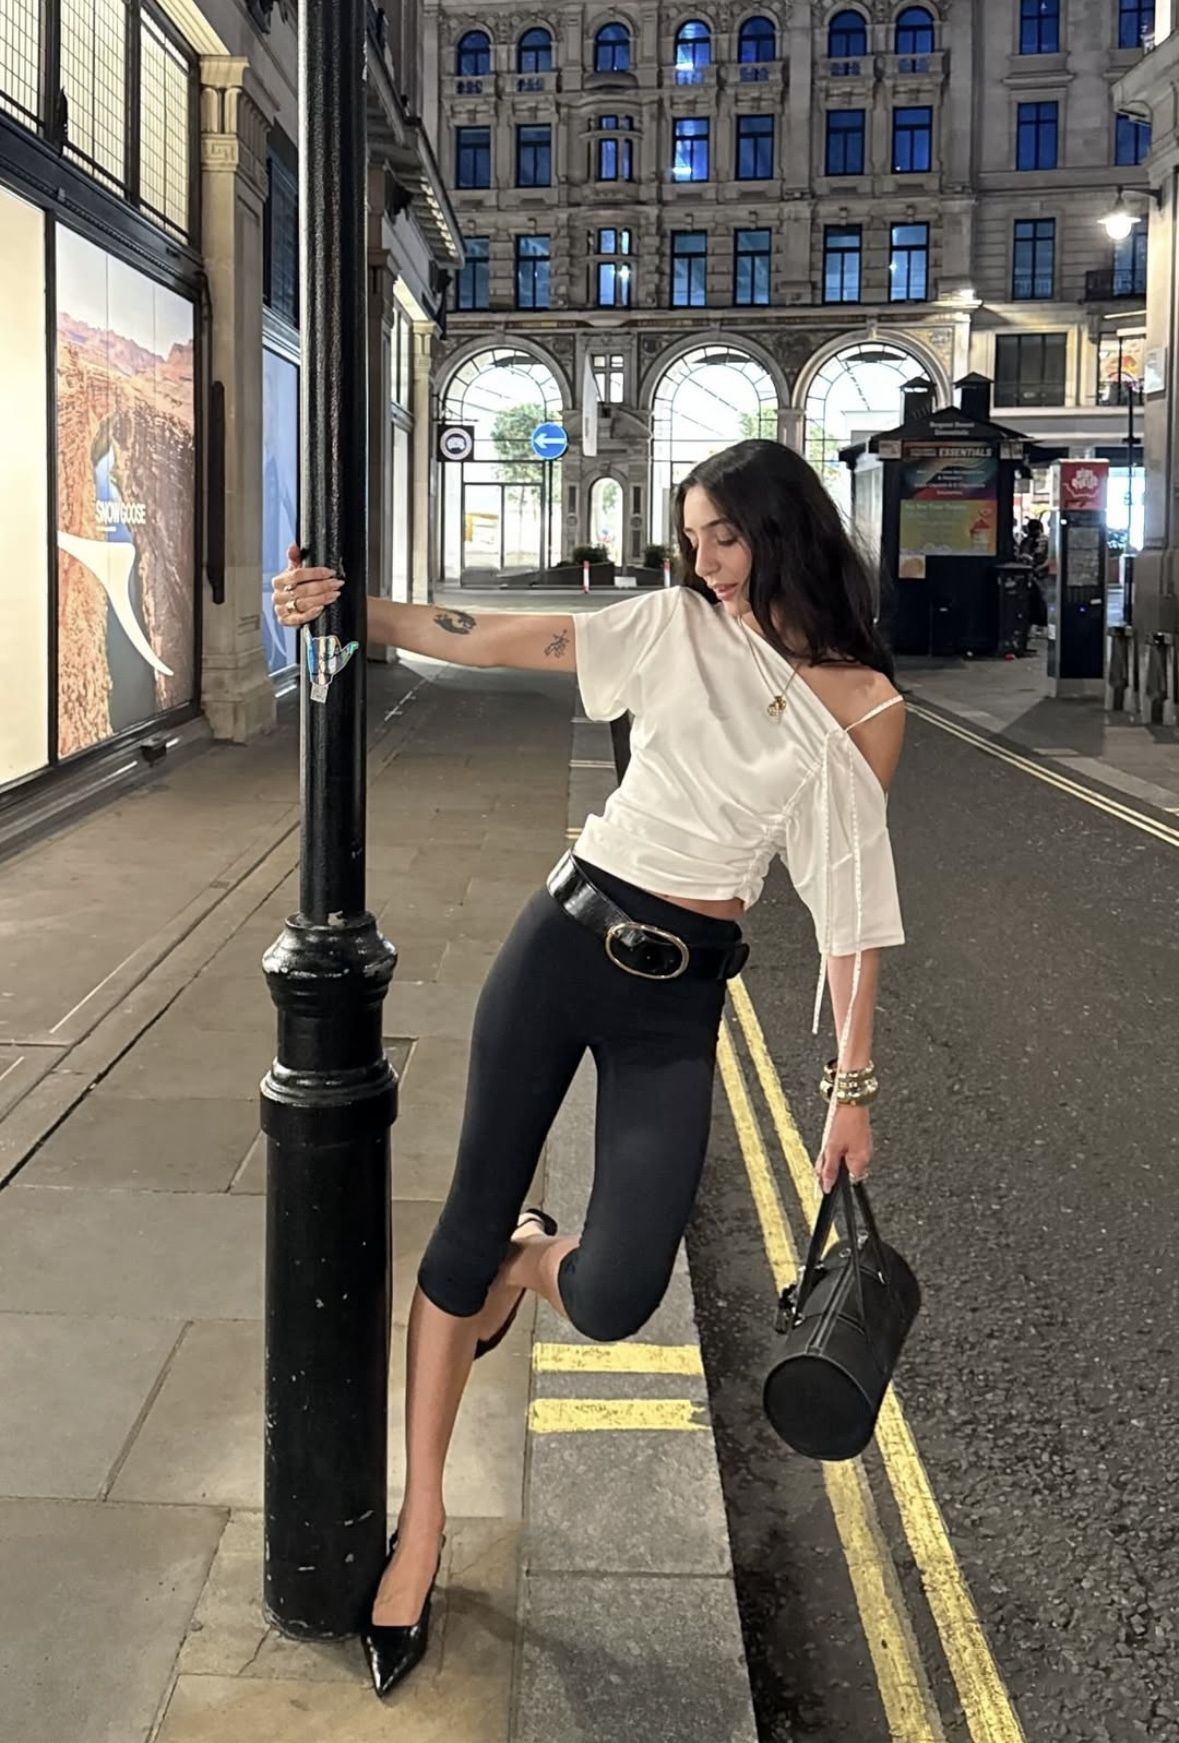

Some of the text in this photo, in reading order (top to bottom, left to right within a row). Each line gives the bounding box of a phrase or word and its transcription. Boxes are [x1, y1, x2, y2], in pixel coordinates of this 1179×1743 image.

[939, 448, 992, 457] ESSENTIALS
[96, 500, 146, 525] SNOW GOOSE
